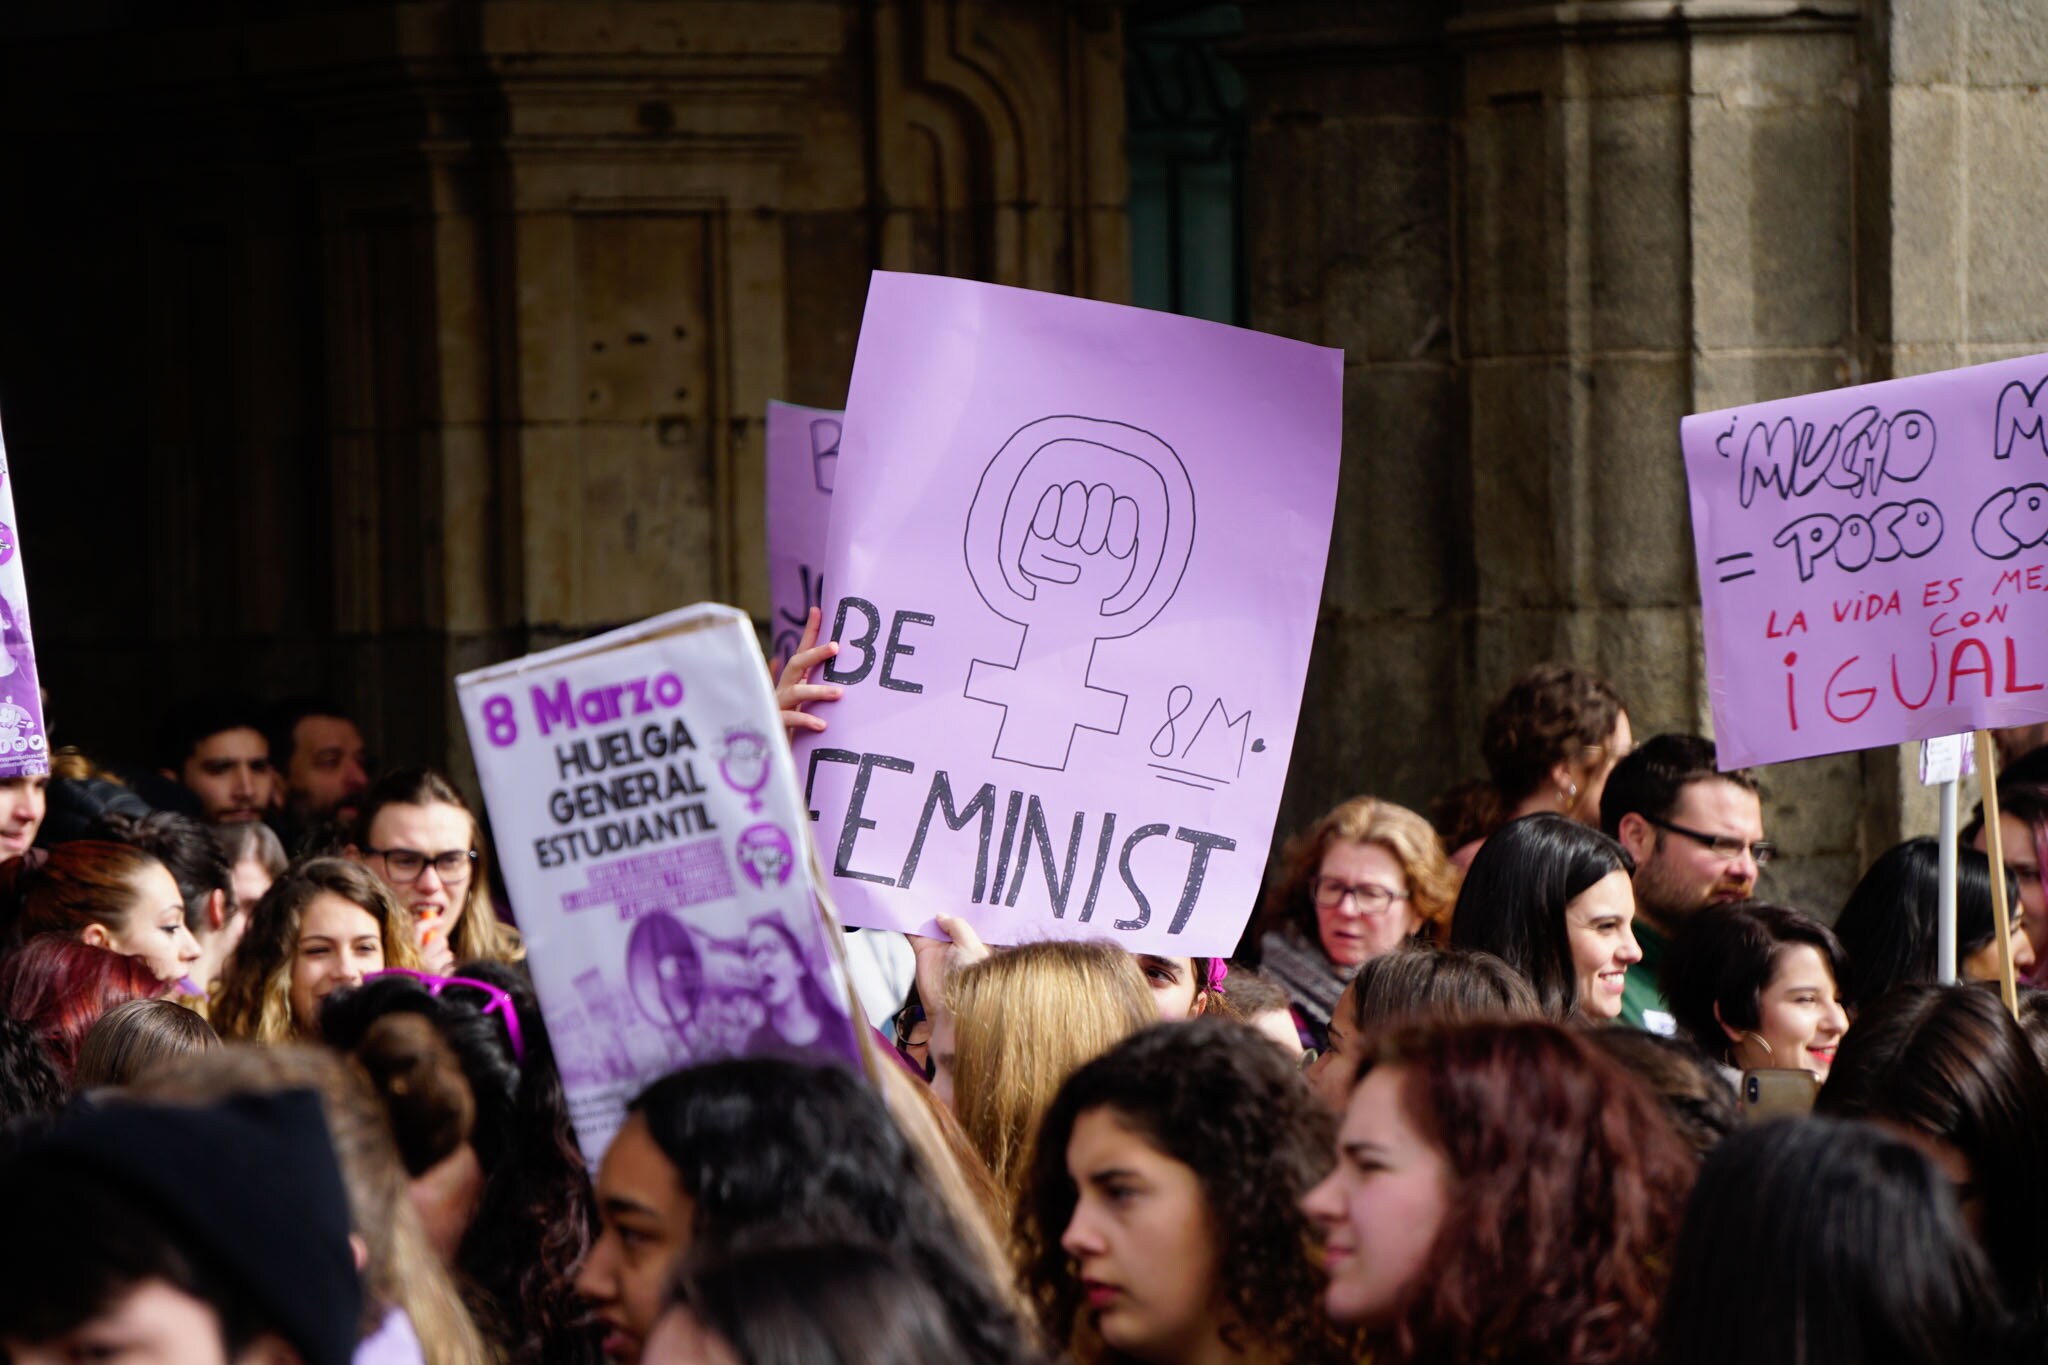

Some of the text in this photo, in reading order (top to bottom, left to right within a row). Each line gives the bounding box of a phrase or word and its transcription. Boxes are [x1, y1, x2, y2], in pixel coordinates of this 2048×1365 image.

[1766, 609, 1808, 639] LA
[1922, 577, 1964, 608] ES
[1991, 564, 2048, 597] ME
[1929, 603, 2008, 637] CON
[822, 596, 936, 694] BE
[481, 671, 684, 749] 8 Marzo
[1149, 684, 1252, 779] 8M
[554, 716, 697, 780] HUELGA
[549, 759, 707, 825] GENERAL
[533, 801, 718, 869] ESTUDIANTIL
[804, 748, 1237, 935] FEMINIST
